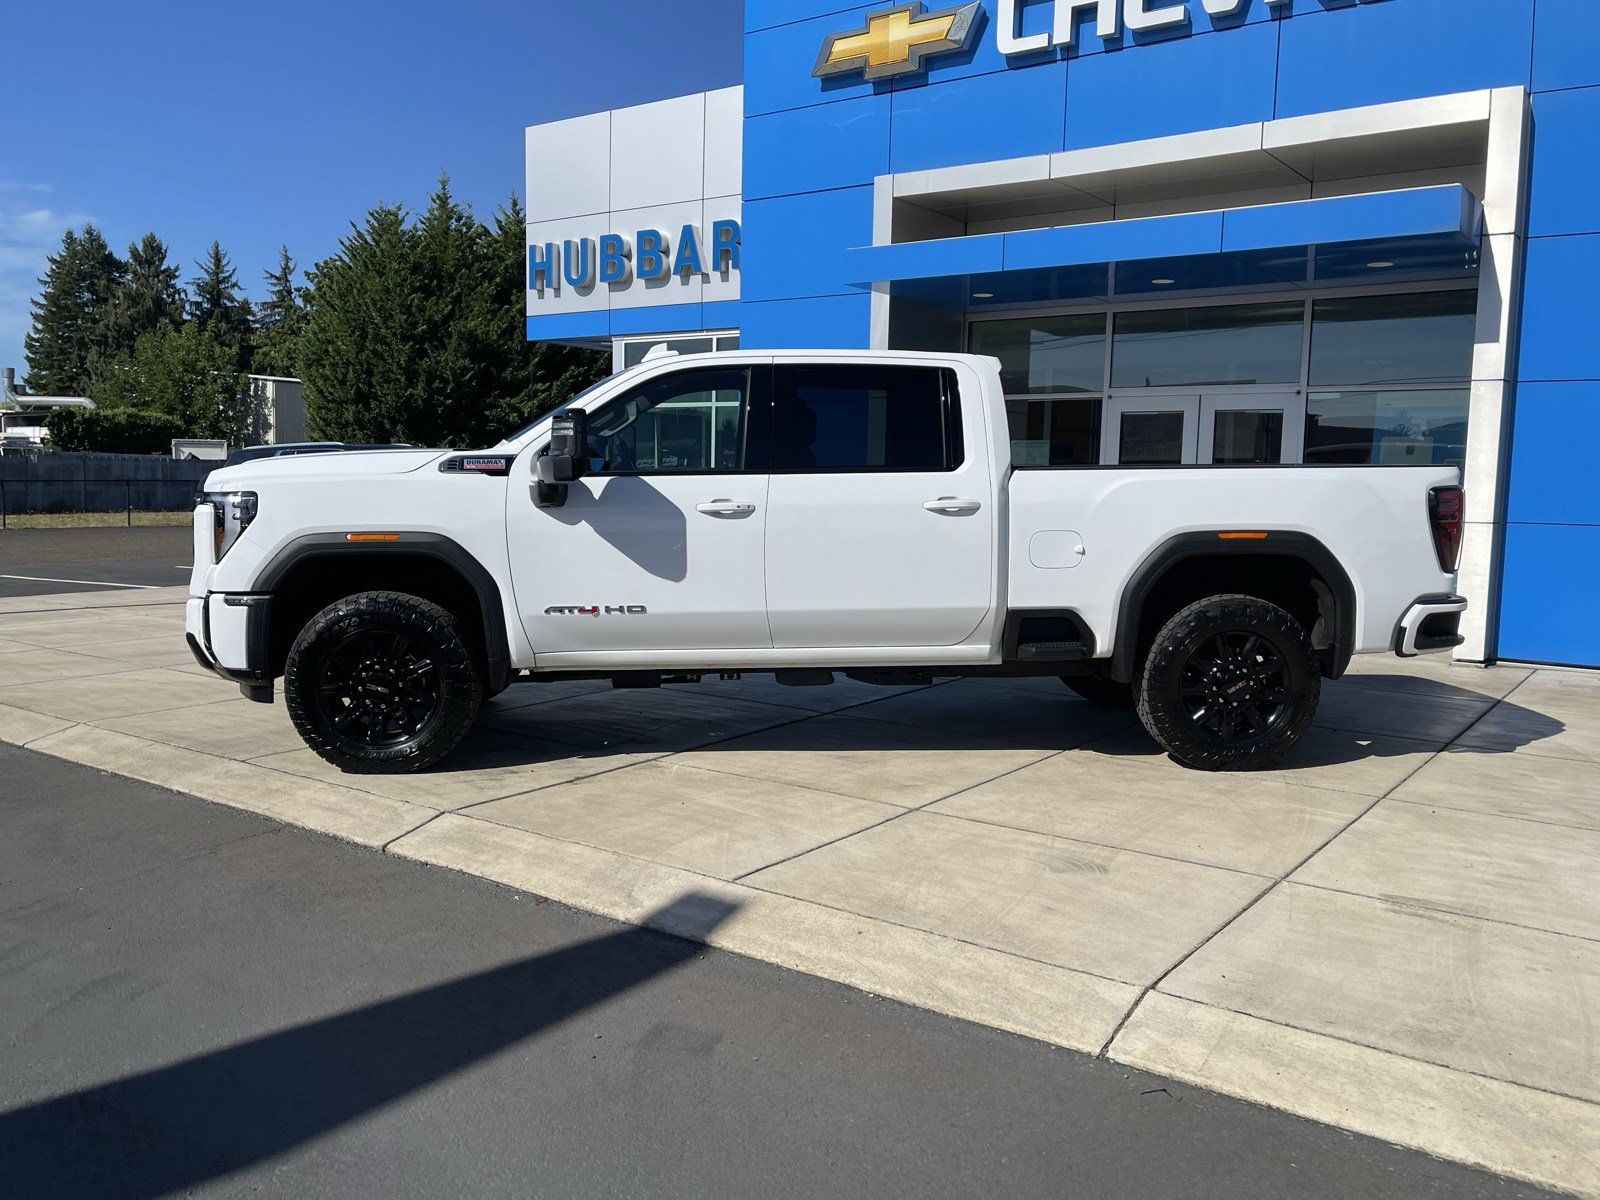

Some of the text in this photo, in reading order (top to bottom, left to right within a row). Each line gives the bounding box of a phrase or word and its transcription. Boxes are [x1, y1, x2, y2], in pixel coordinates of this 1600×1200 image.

[528, 219, 741, 294] HUBBAR
[466, 458, 503, 466] DURAMAX
[544, 605, 648, 618] AT4 HD
